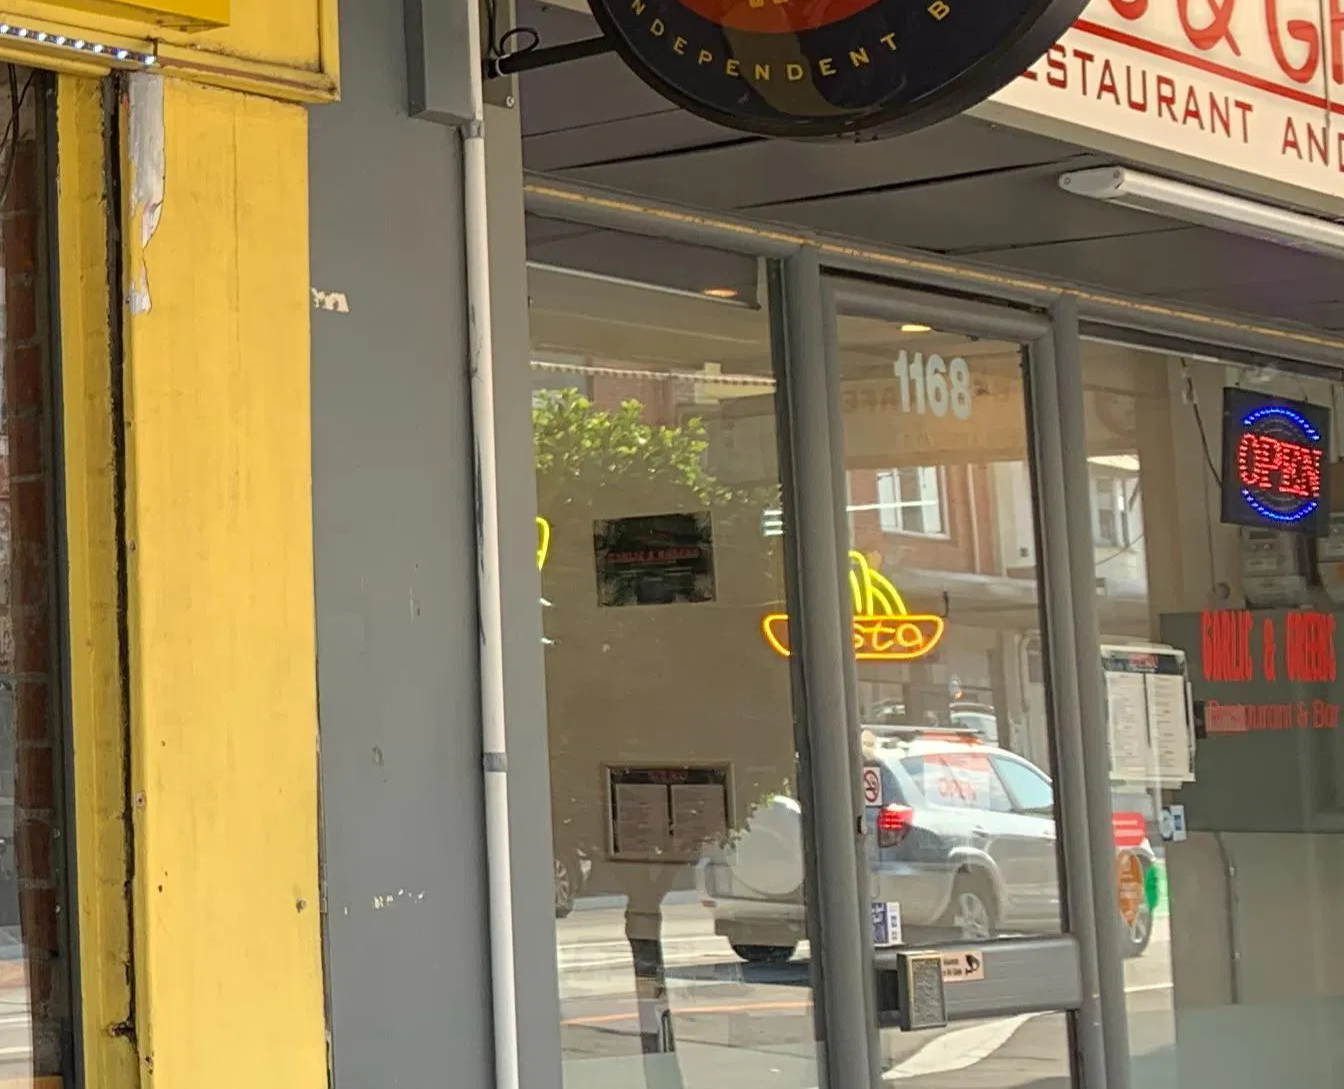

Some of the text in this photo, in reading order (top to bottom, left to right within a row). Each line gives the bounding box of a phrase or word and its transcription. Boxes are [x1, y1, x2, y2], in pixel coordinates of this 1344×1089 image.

[1021, 44, 1344, 173] STAURANT AN
[894, 350, 972, 419] 1168
[1239, 432, 1323, 498] OPEN
[1286, 611, 1337, 682] GREENS
[1313, 698, 1341, 729] Bar
